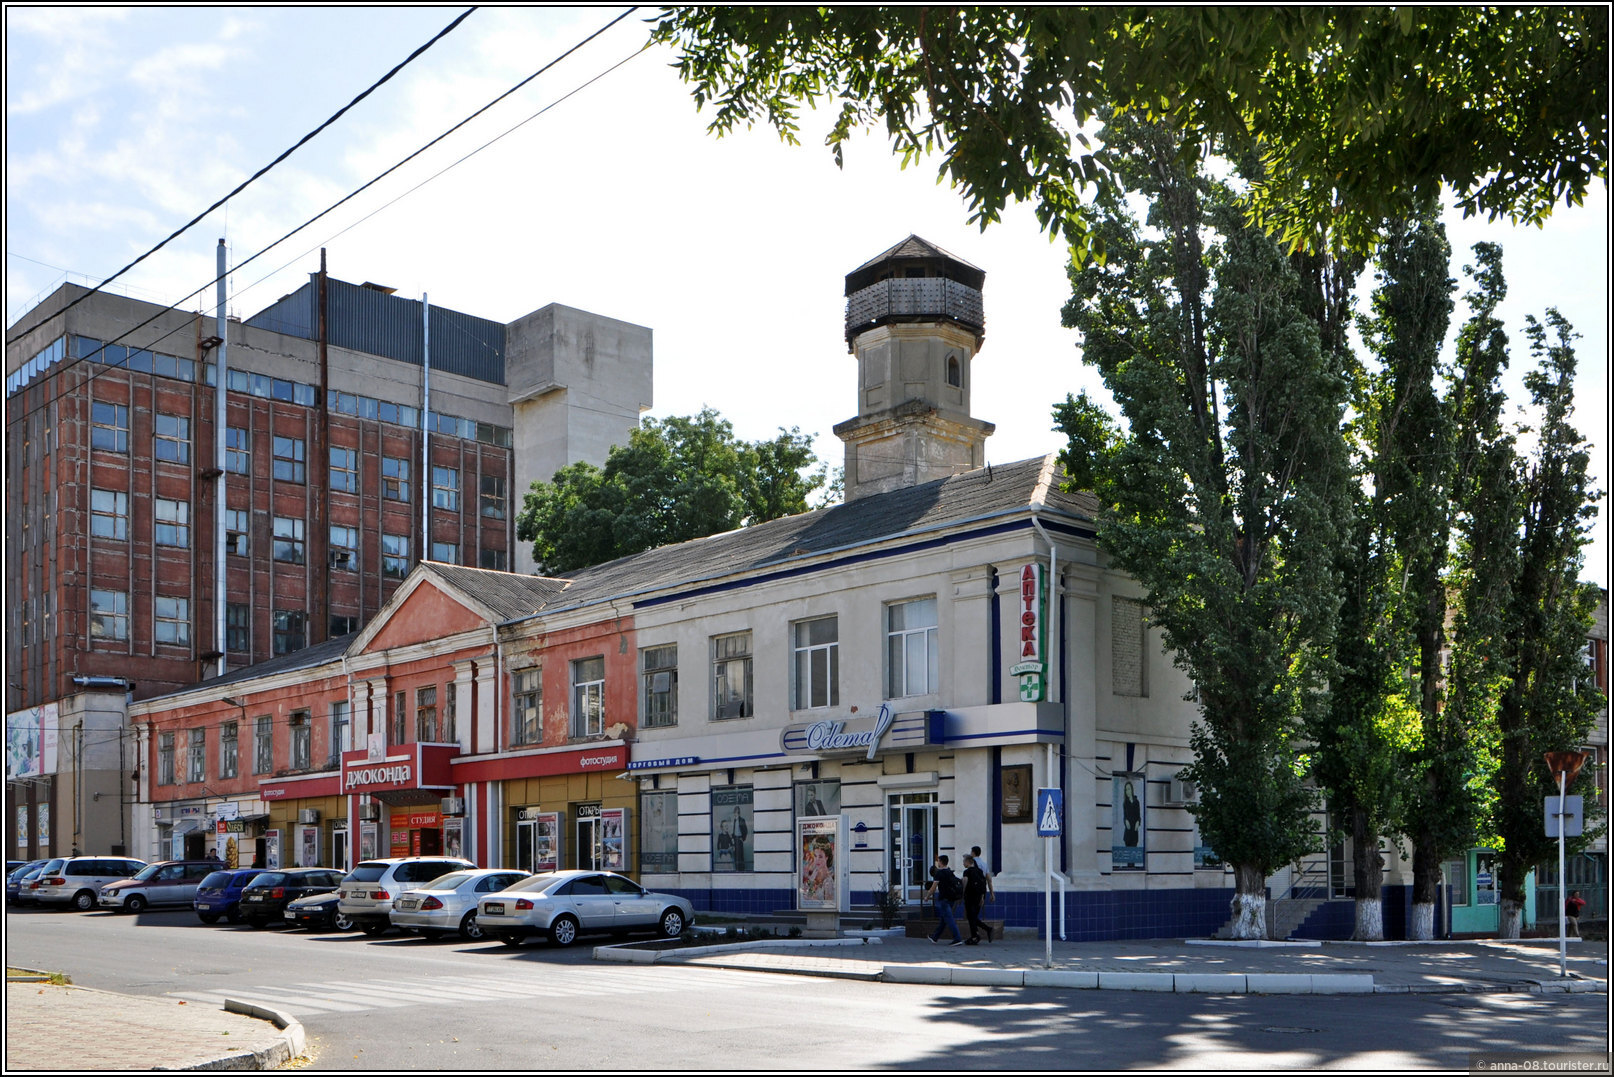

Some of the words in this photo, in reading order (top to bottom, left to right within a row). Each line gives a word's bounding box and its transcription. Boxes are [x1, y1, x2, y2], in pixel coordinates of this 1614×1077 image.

[580, 755, 618, 769] фотостудия
[675, 757, 694, 766] ДОМ
[410, 815, 436, 825] СТУДИЯ
